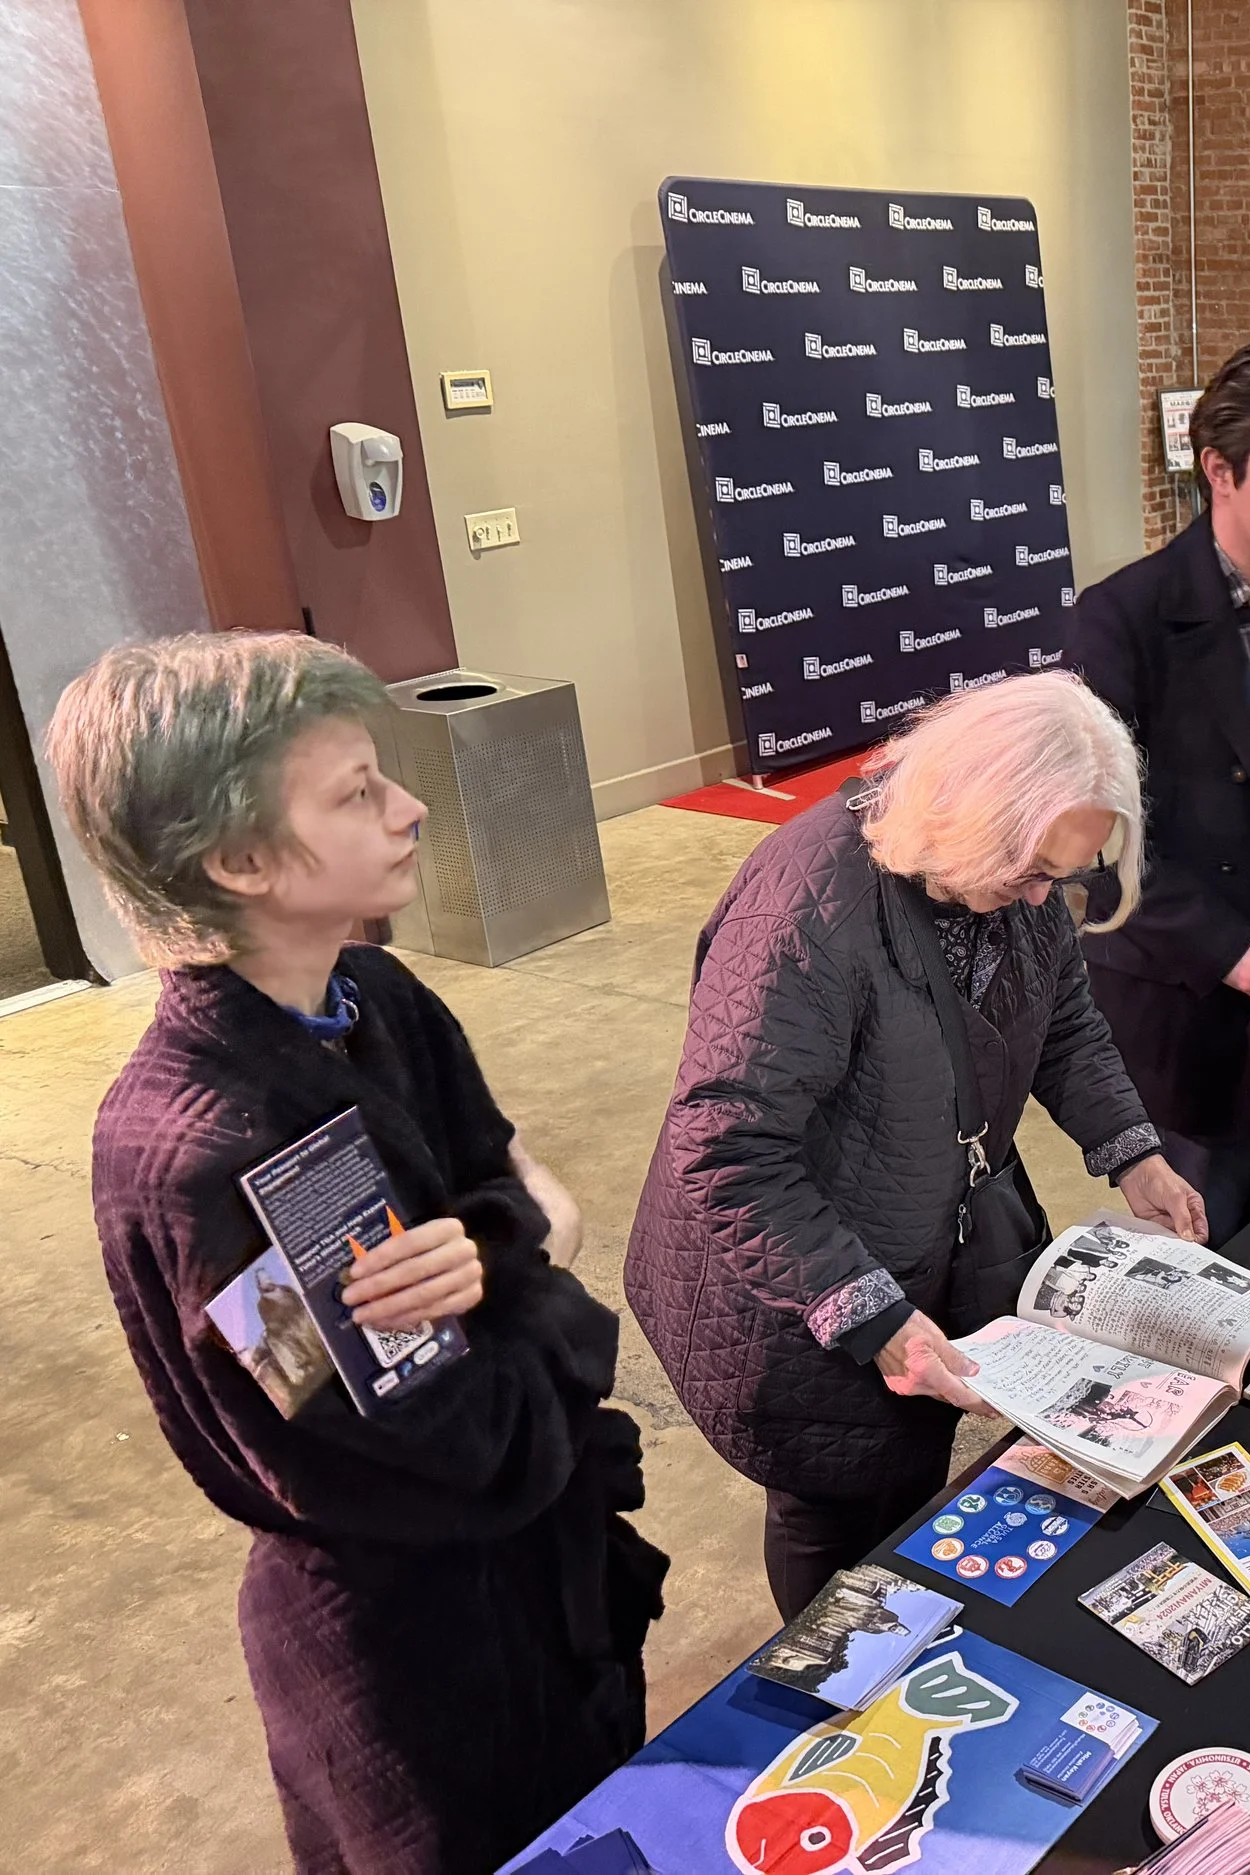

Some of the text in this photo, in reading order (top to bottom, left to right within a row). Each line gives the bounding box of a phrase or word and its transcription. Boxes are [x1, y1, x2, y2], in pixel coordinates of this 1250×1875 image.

[971, 1520, 1001, 1549] ALLIANCE
[1155, 1576, 1212, 1621] MIYANAVI2024
[1212, 1592, 1238, 1617] CITY
[1167, 1755, 1241, 1783] UTSUNOMIYA, JAPAN
[1165, 1812, 1187, 1834] OKLAHO
